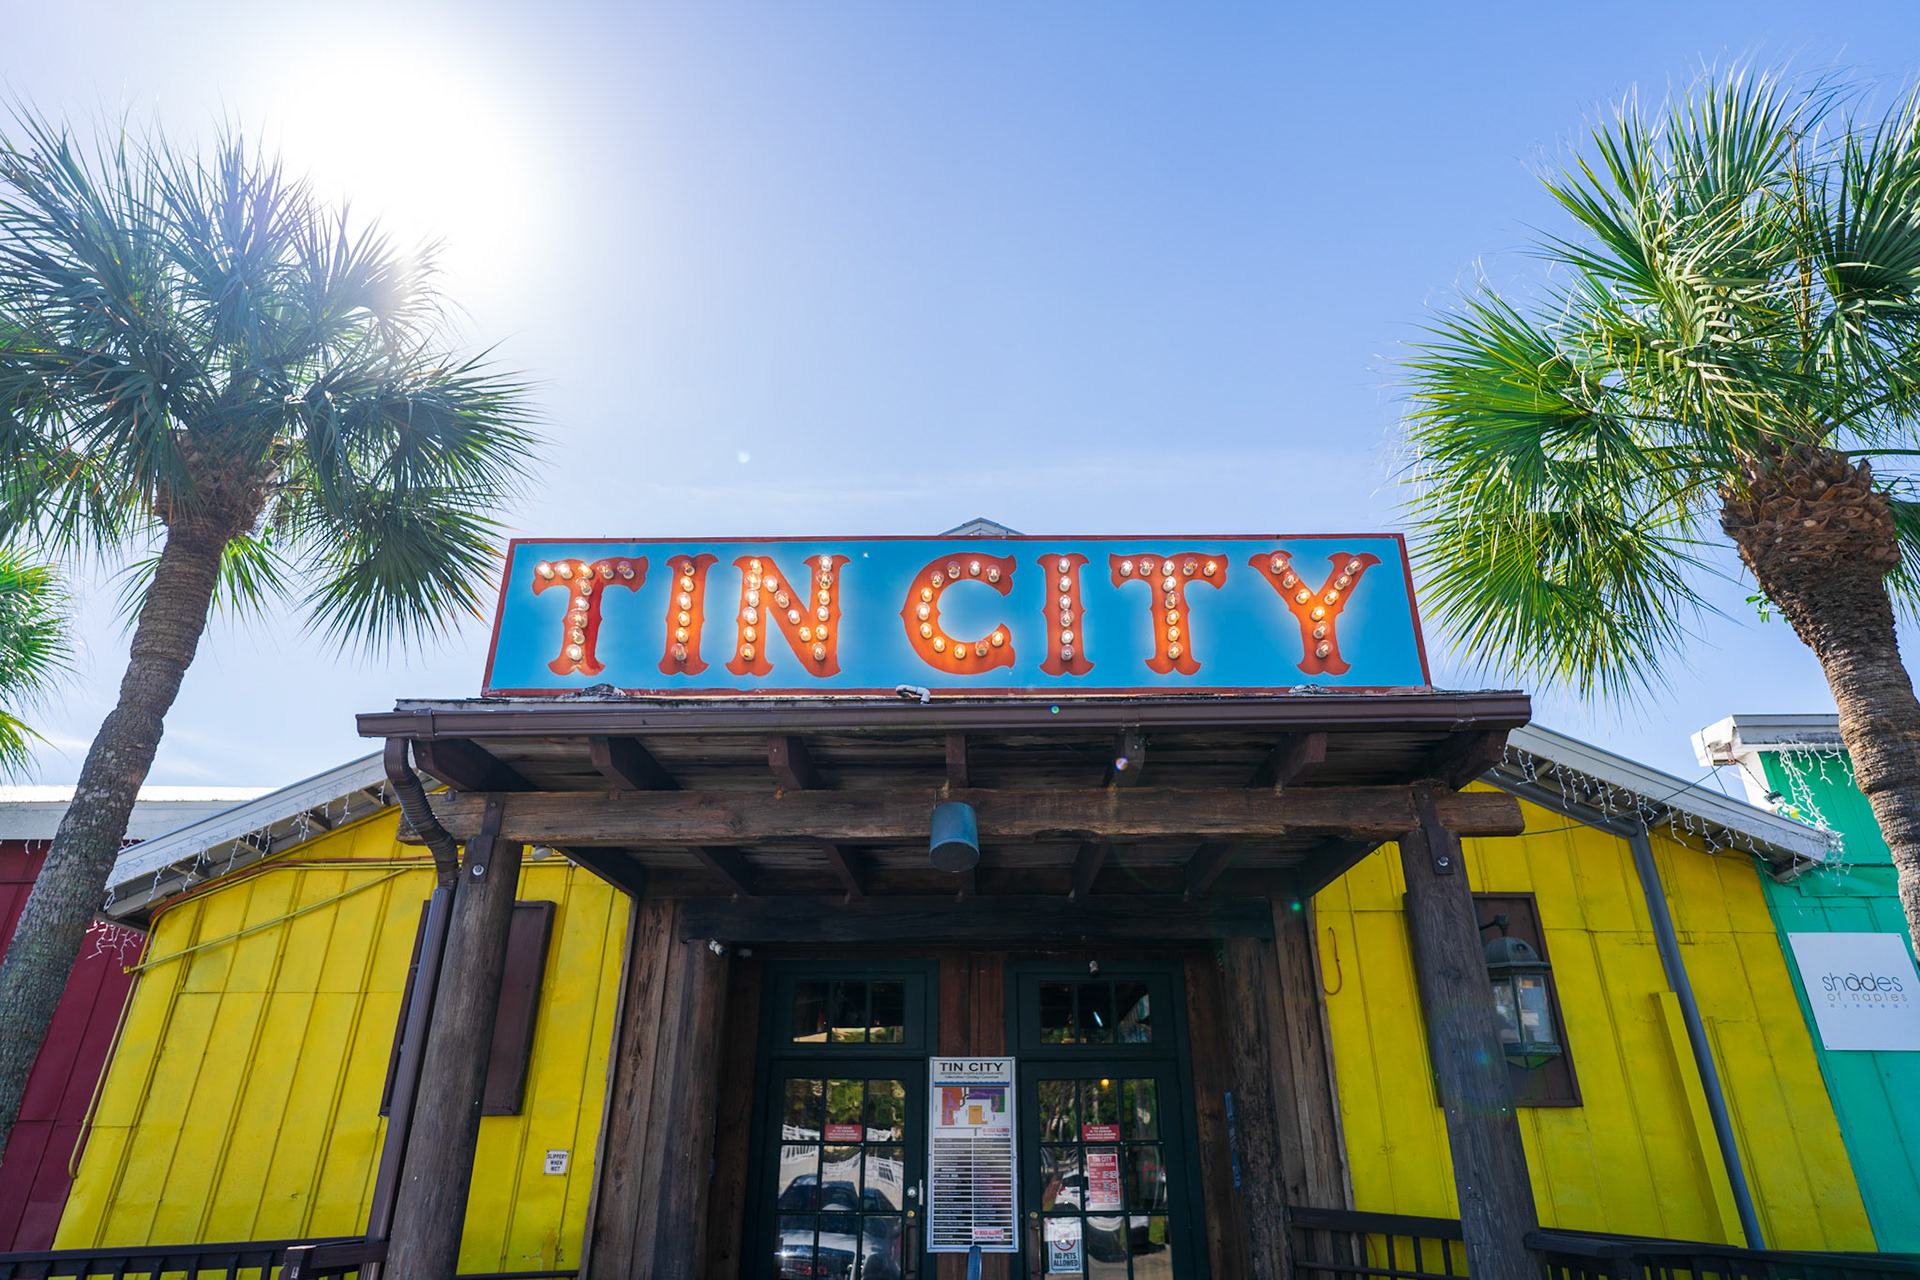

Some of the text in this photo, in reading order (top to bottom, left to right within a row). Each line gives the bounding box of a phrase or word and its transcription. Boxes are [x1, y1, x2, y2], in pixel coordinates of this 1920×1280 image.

[533, 552, 1382, 678] TIN CITY
[1822, 972, 1903, 992] shades
[1827, 991, 1908, 1003] of naples
[939, 1062, 1003, 1072] TIN CITY
